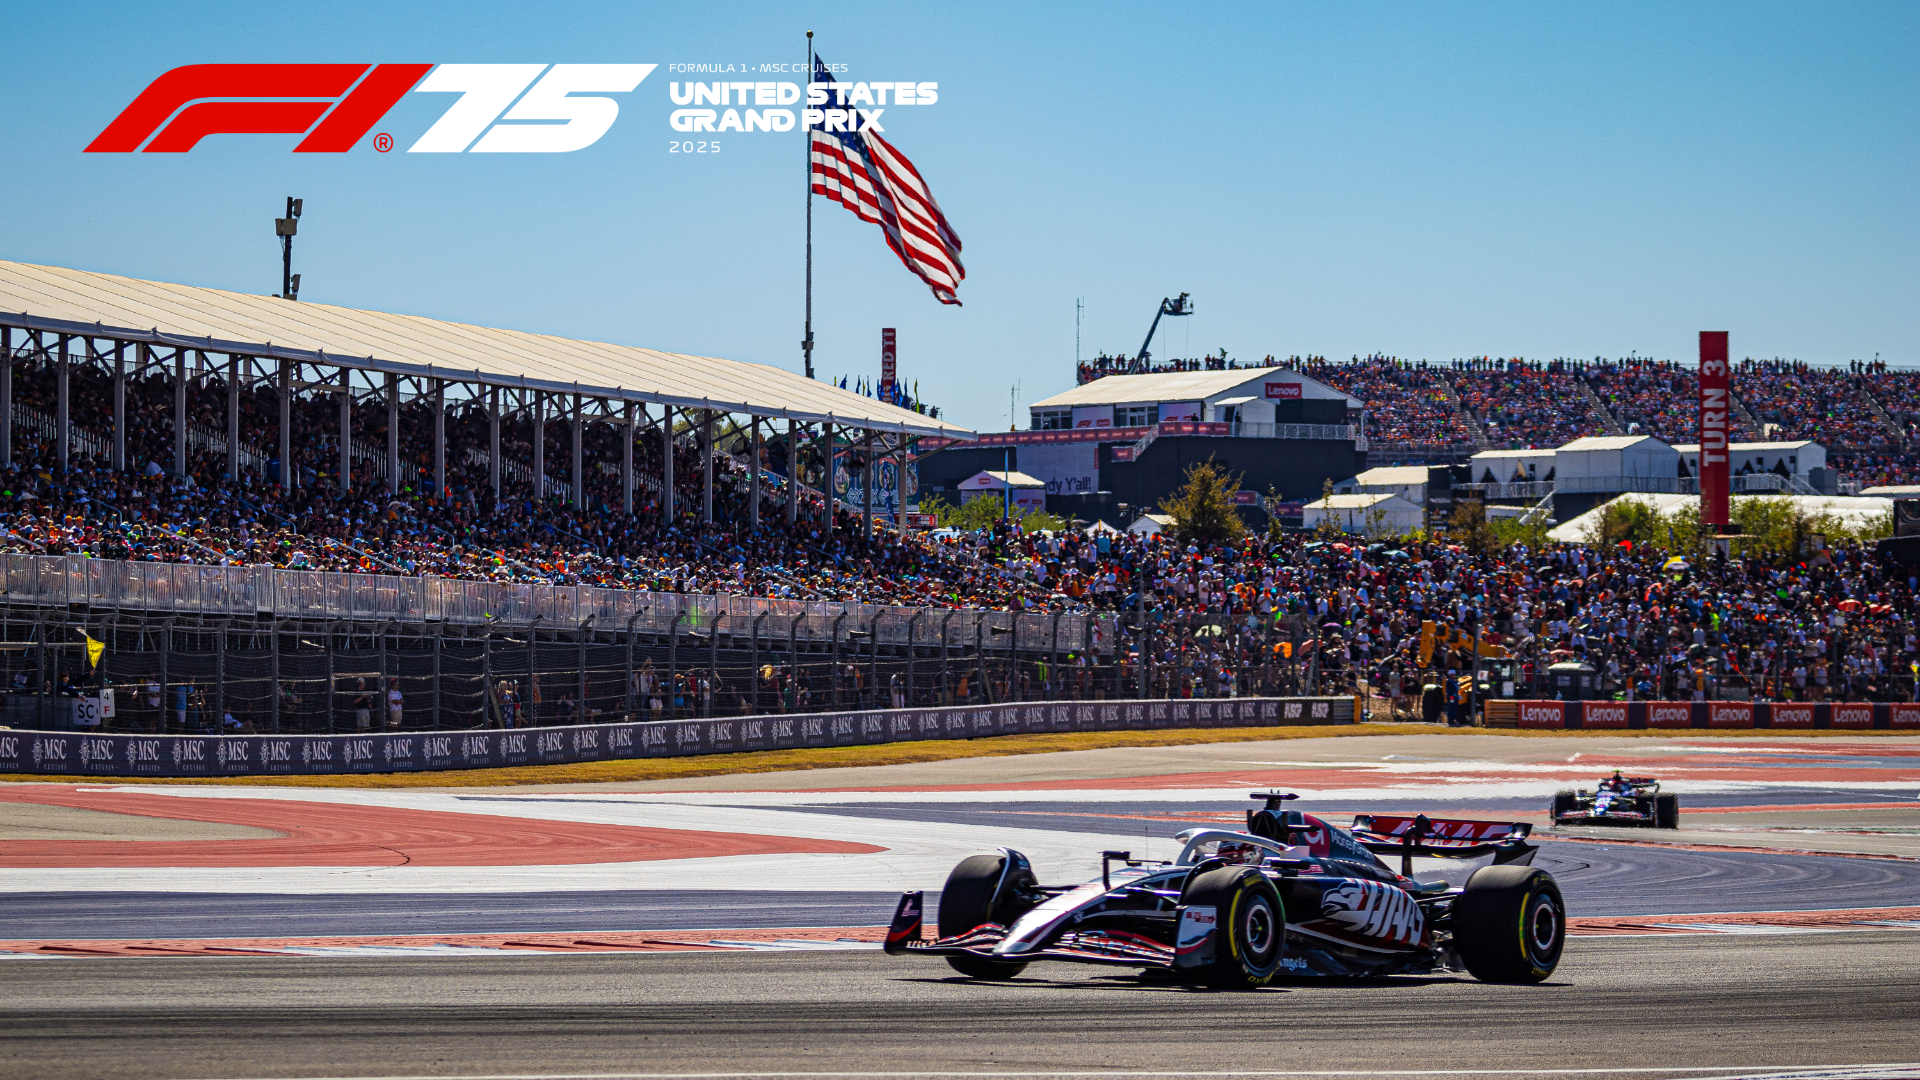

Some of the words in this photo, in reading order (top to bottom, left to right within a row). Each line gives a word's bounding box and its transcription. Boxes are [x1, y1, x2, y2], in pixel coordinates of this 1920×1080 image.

[883, 352, 894, 380] RED
[1702, 359, 1726, 377] 3
[1267, 385, 1300, 396] Lenovo
[1702, 389, 1727, 467] TURN
[1065, 476, 1092, 492] Y'all!
[104, 692, 110, 701] 4
[77, 703, 95, 719] SC
[104, 705, 111, 715] F
[1521, 704, 1561, 722] Lenovo
[1586, 705, 1625, 721] Lenovo
[1649, 705, 1689, 722] Lenovo
[1711, 705, 1751, 721] Lenovo
[1773, 706, 1812, 722] Lenovo
[1834, 707, 1871, 722] Lenovo
[748, 721, 764, 738] MSC
[779, 720, 794, 737] MSC
[809, 719, 824, 735] MSC
[838, 716, 853, 734] MSC
[868, 715, 884, 732] MSC
[897, 715, 911, 731] MSC
[925, 713, 939, 729] MSC
[581, 730, 599, 748] MSC
[616, 728, 633, 746] MSC
[650, 726, 667, 744] MSC
[684, 725, 700, 742] MSC
[716, 723, 733, 740] MSC
[44, 738, 67, 760] MSC
[91, 739, 114, 760] MSC
[138, 740, 160, 760] MSC
[183, 740, 205, 760] MSC
[228, 741, 249, 760] MSC
[312, 741, 333, 760] MSC
[353, 740, 374, 759] MSC
[393, 739, 412, 758] MSC
[432, 737, 452, 756] MSC
[471, 736, 489, 754] MSC
[508, 734, 527, 753] MSC
[545, 732, 563, 751] MSC
[271, 741, 291, 761] MSC
